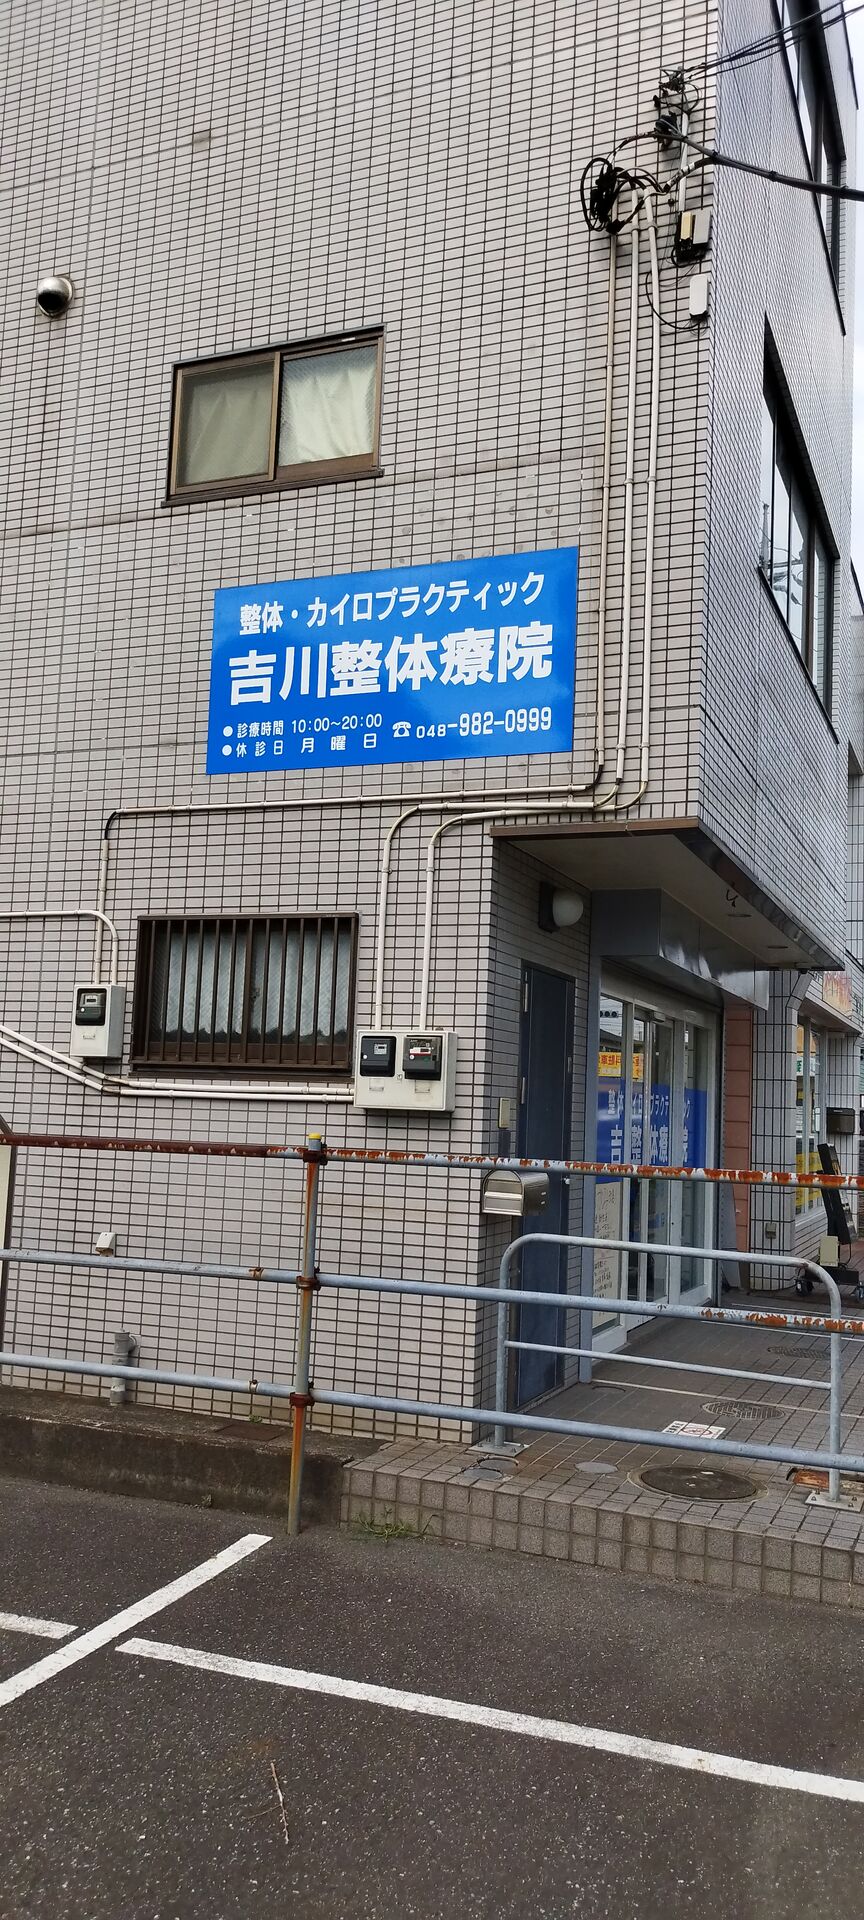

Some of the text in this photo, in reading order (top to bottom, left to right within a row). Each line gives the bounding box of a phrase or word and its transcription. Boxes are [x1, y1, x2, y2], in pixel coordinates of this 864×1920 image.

[239, 571, 545, 636] 整体・カイロプラクティック
[228, 620, 554, 706] 吉川整体療院
[237, 720, 284, 739] 診療時間
[415, 706, 552, 739] 048-982-0999
